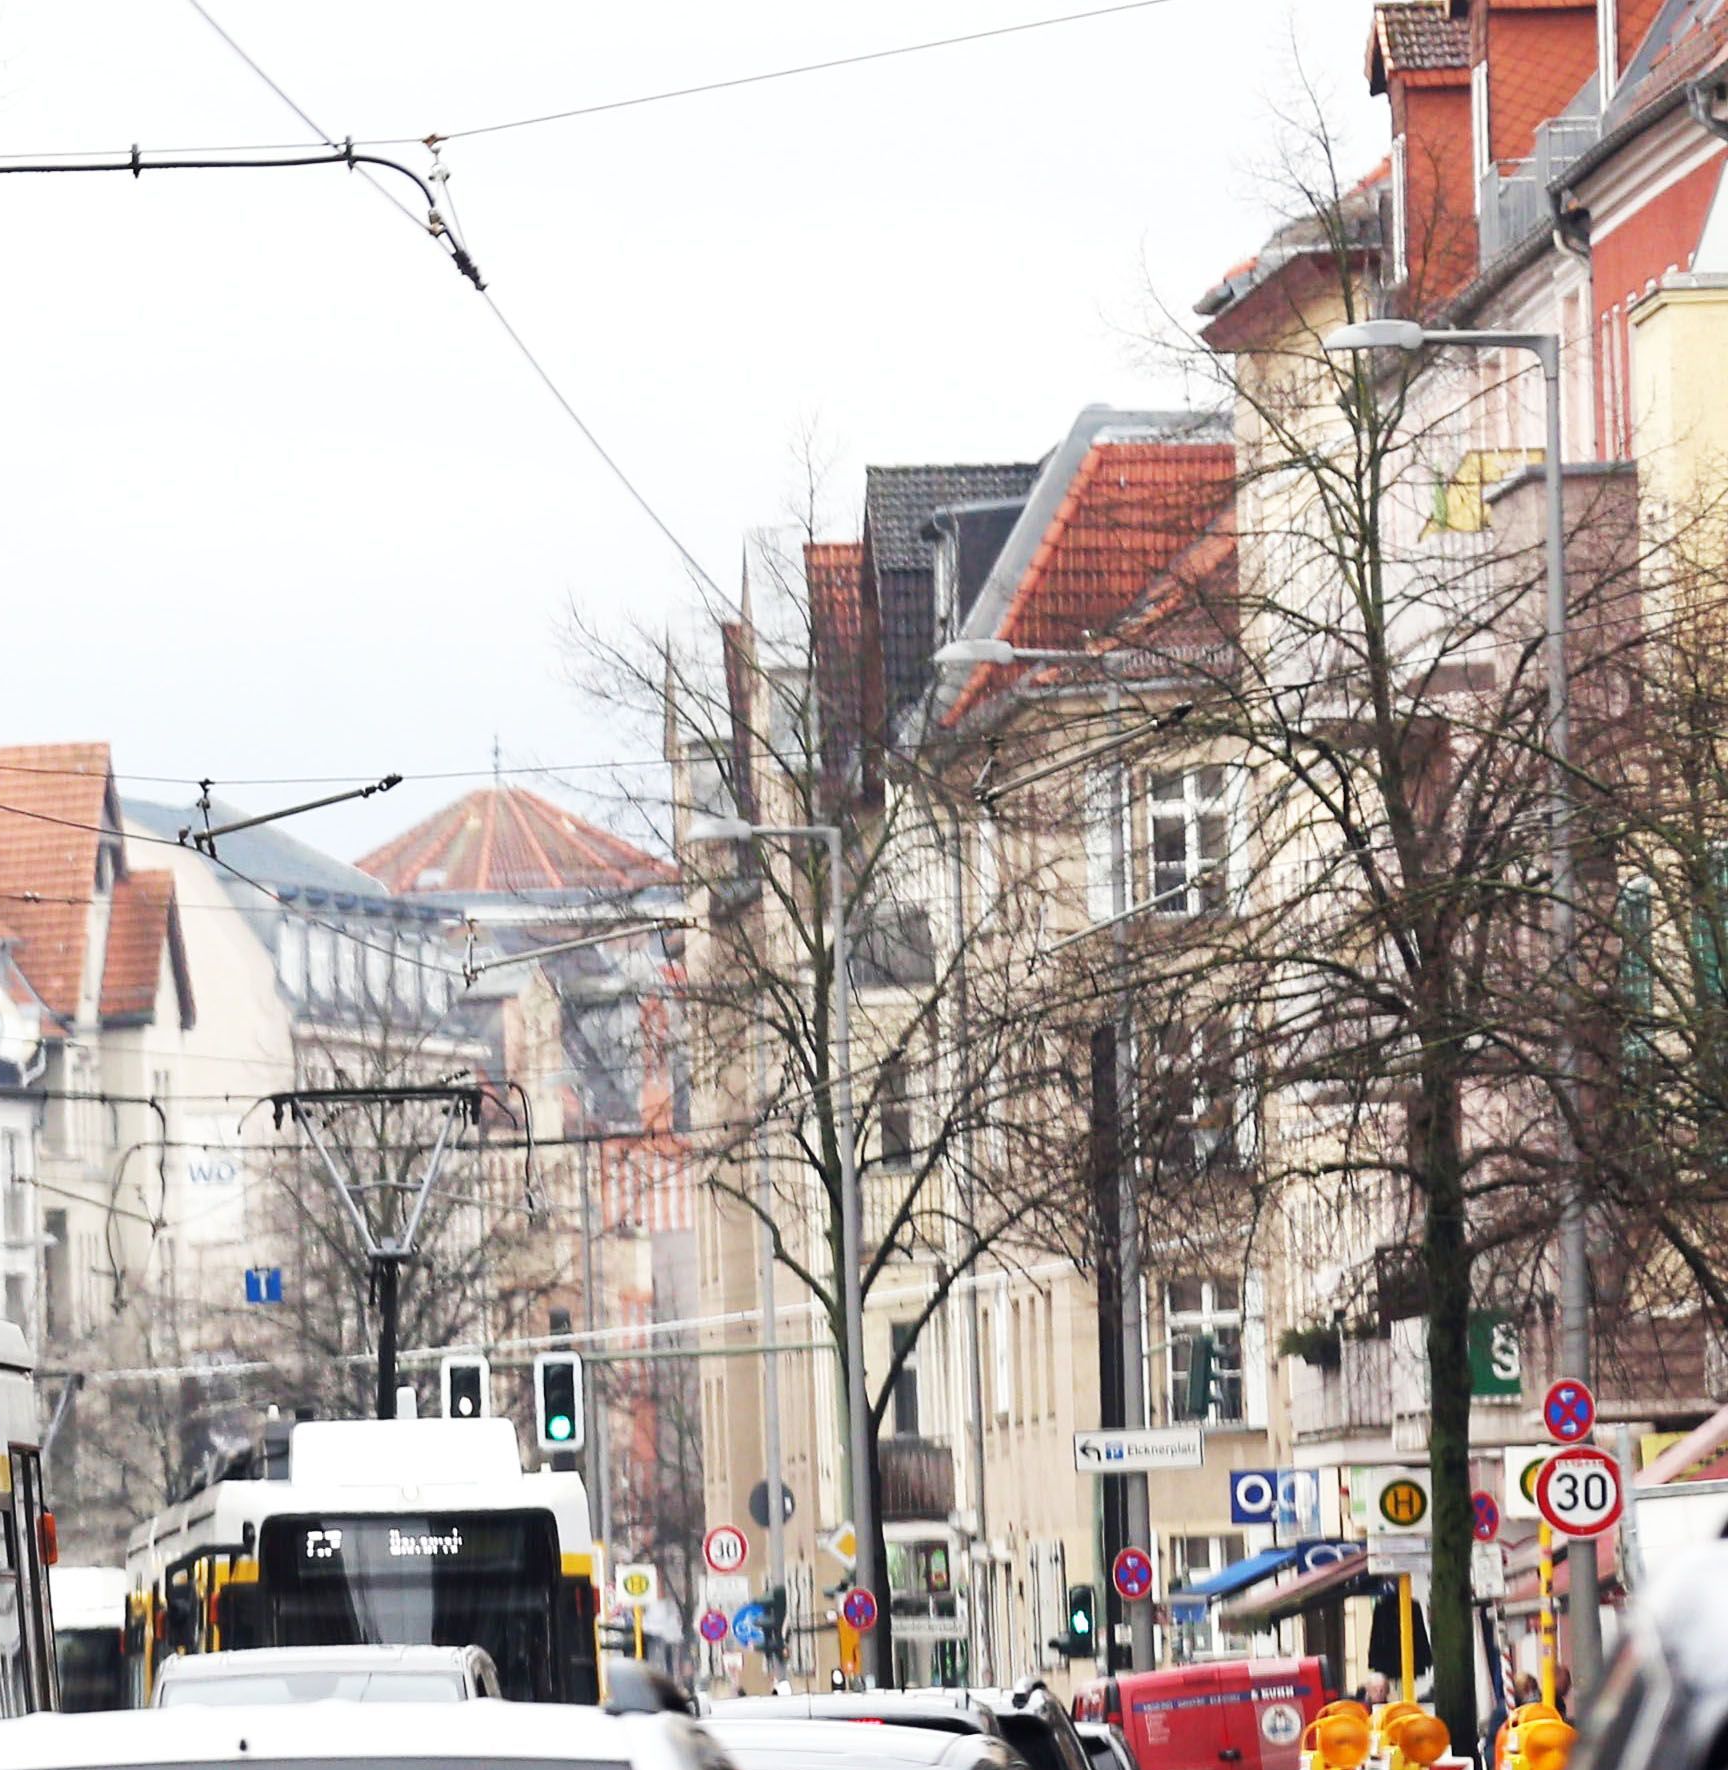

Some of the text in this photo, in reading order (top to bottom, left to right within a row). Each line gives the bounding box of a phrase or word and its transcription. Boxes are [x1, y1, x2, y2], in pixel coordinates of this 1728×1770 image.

[1393, 1489, 1414, 1515] H
[1556, 1473, 1607, 1511] 30
[714, 1539, 739, 1558] 30
